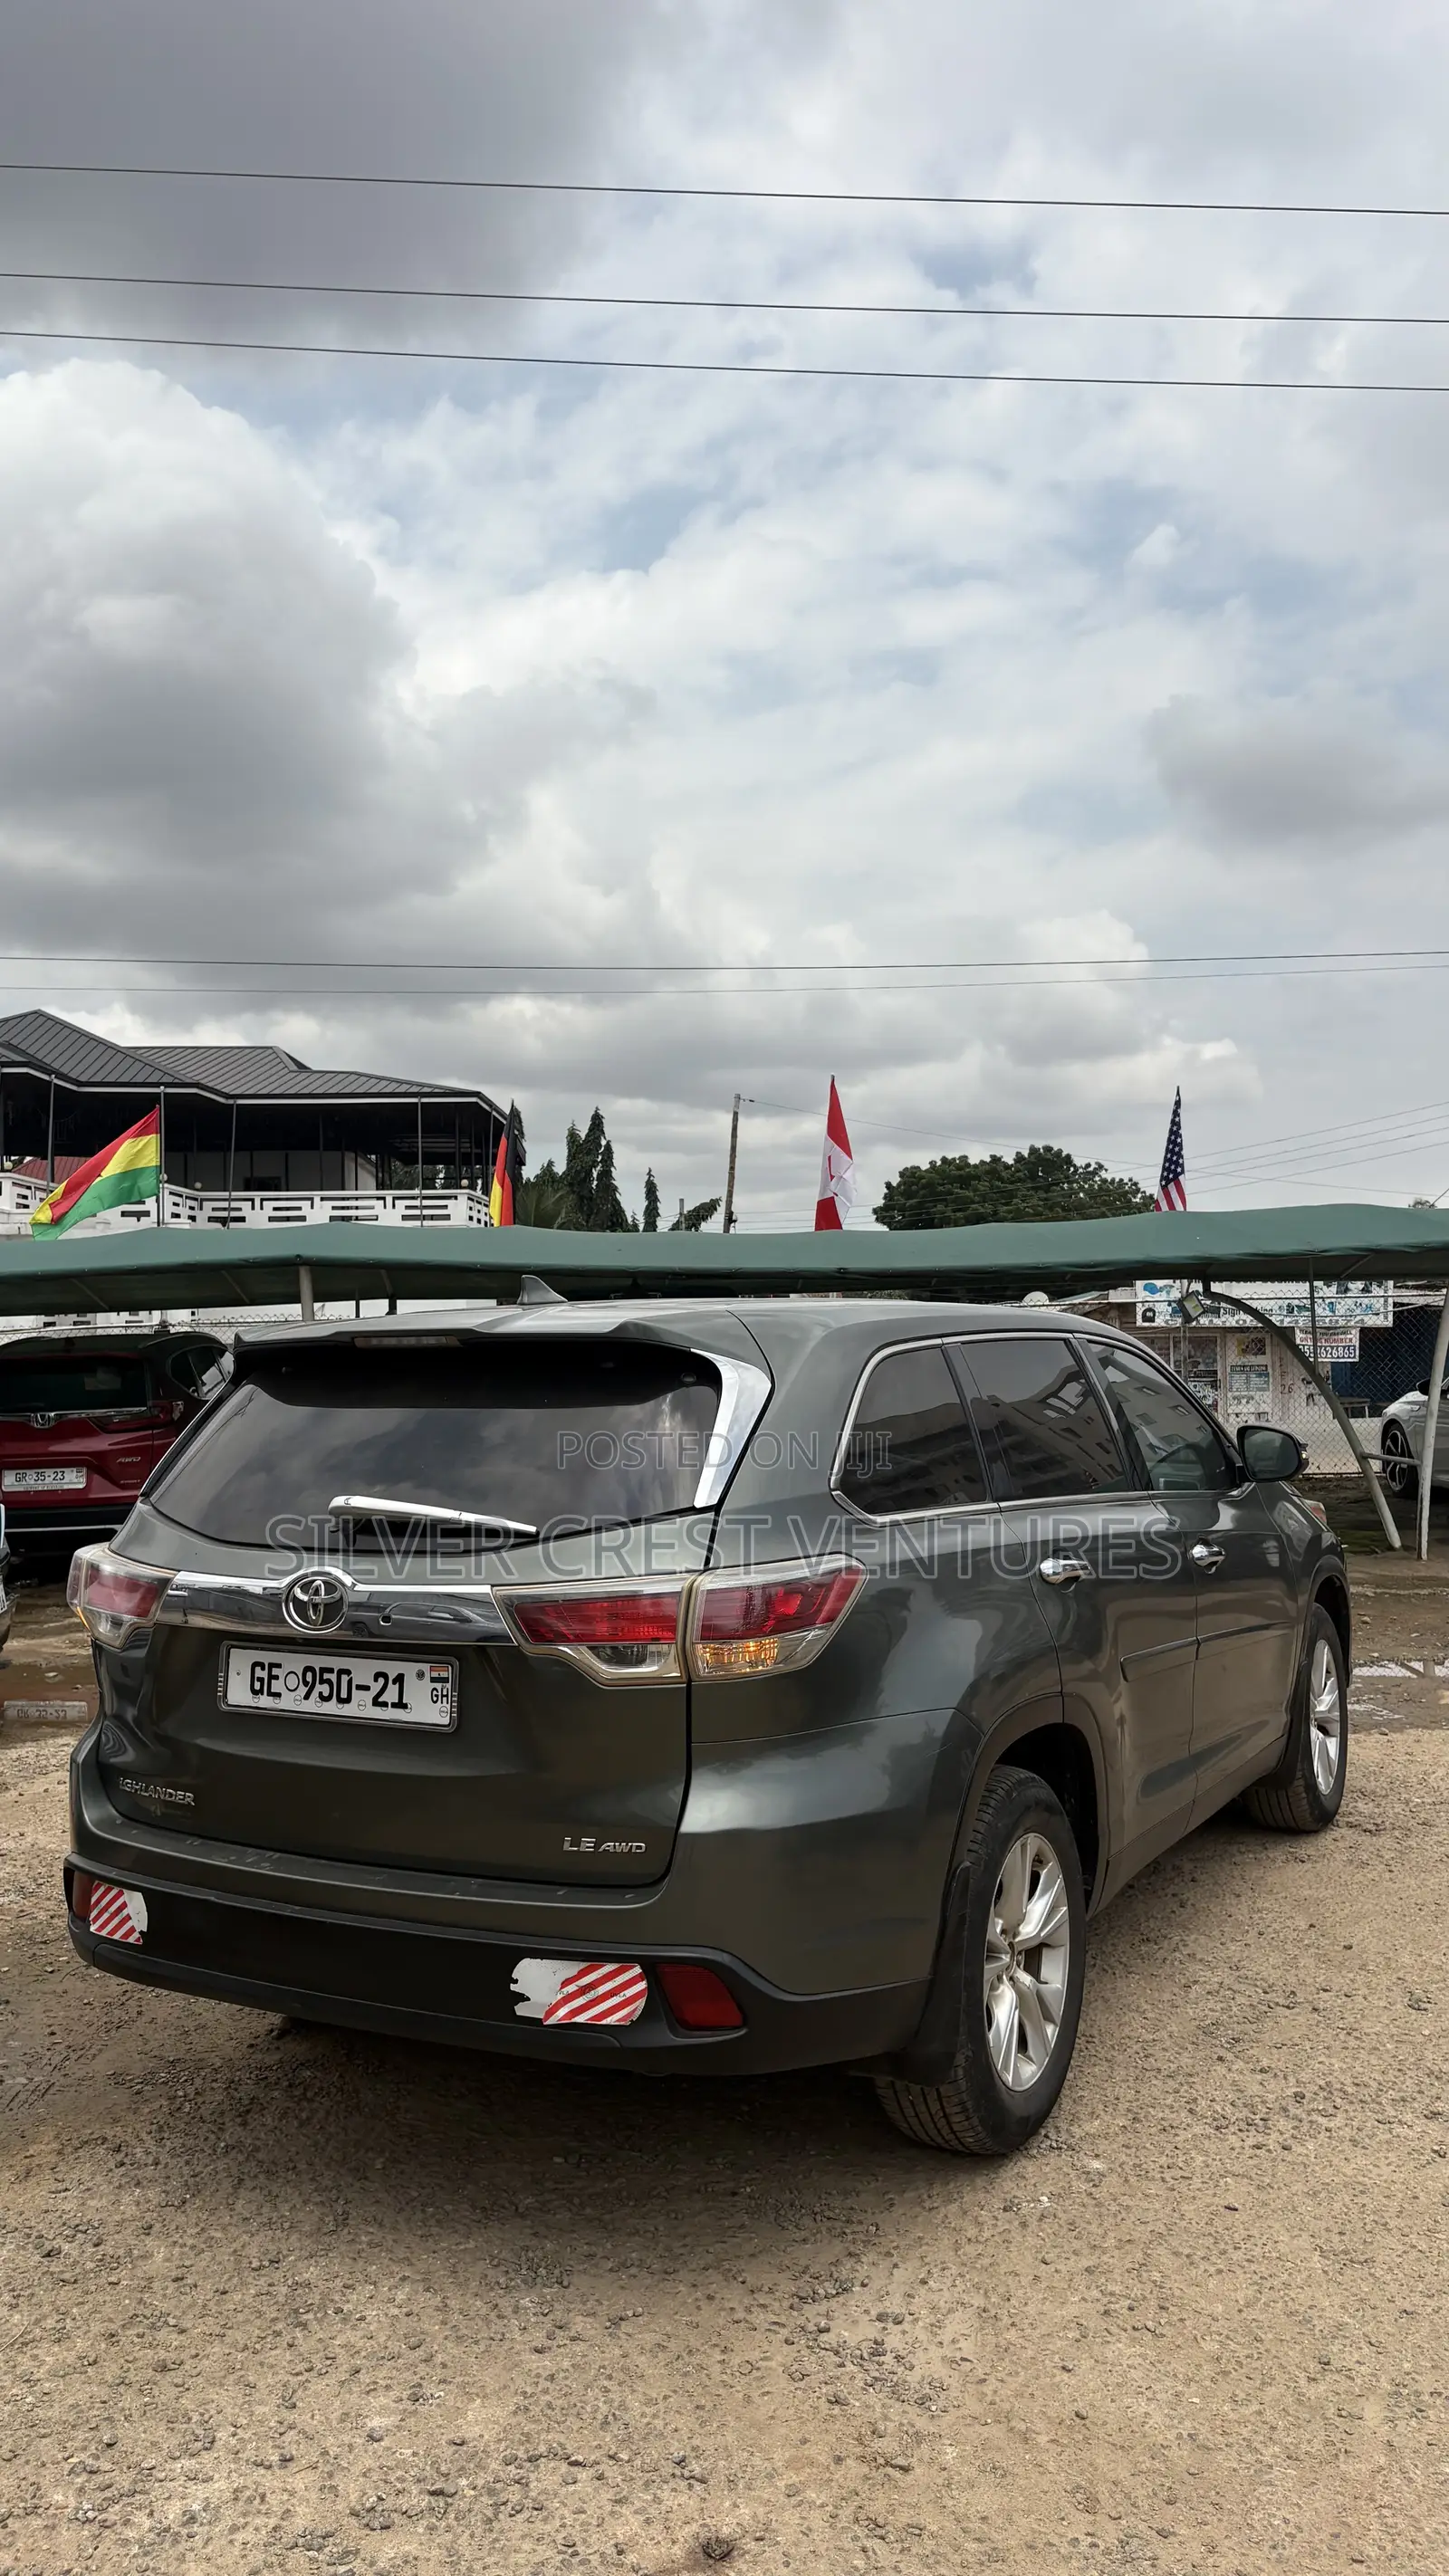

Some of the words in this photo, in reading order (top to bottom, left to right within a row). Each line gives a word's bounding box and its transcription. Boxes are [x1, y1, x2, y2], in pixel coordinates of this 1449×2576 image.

[1324, 1336, 1354, 1345] NUMBER
[14, 1471, 28, 1483] GR
[34, 1470, 66, 1482] 35-23
[249, 1660, 283, 1699] GE
[301, 1664, 409, 1710] 950-21
[430, 1686, 450, 1705] GH
[562, 1837, 597, 1852] LE
[598, 1842, 647, 1853] AWD
